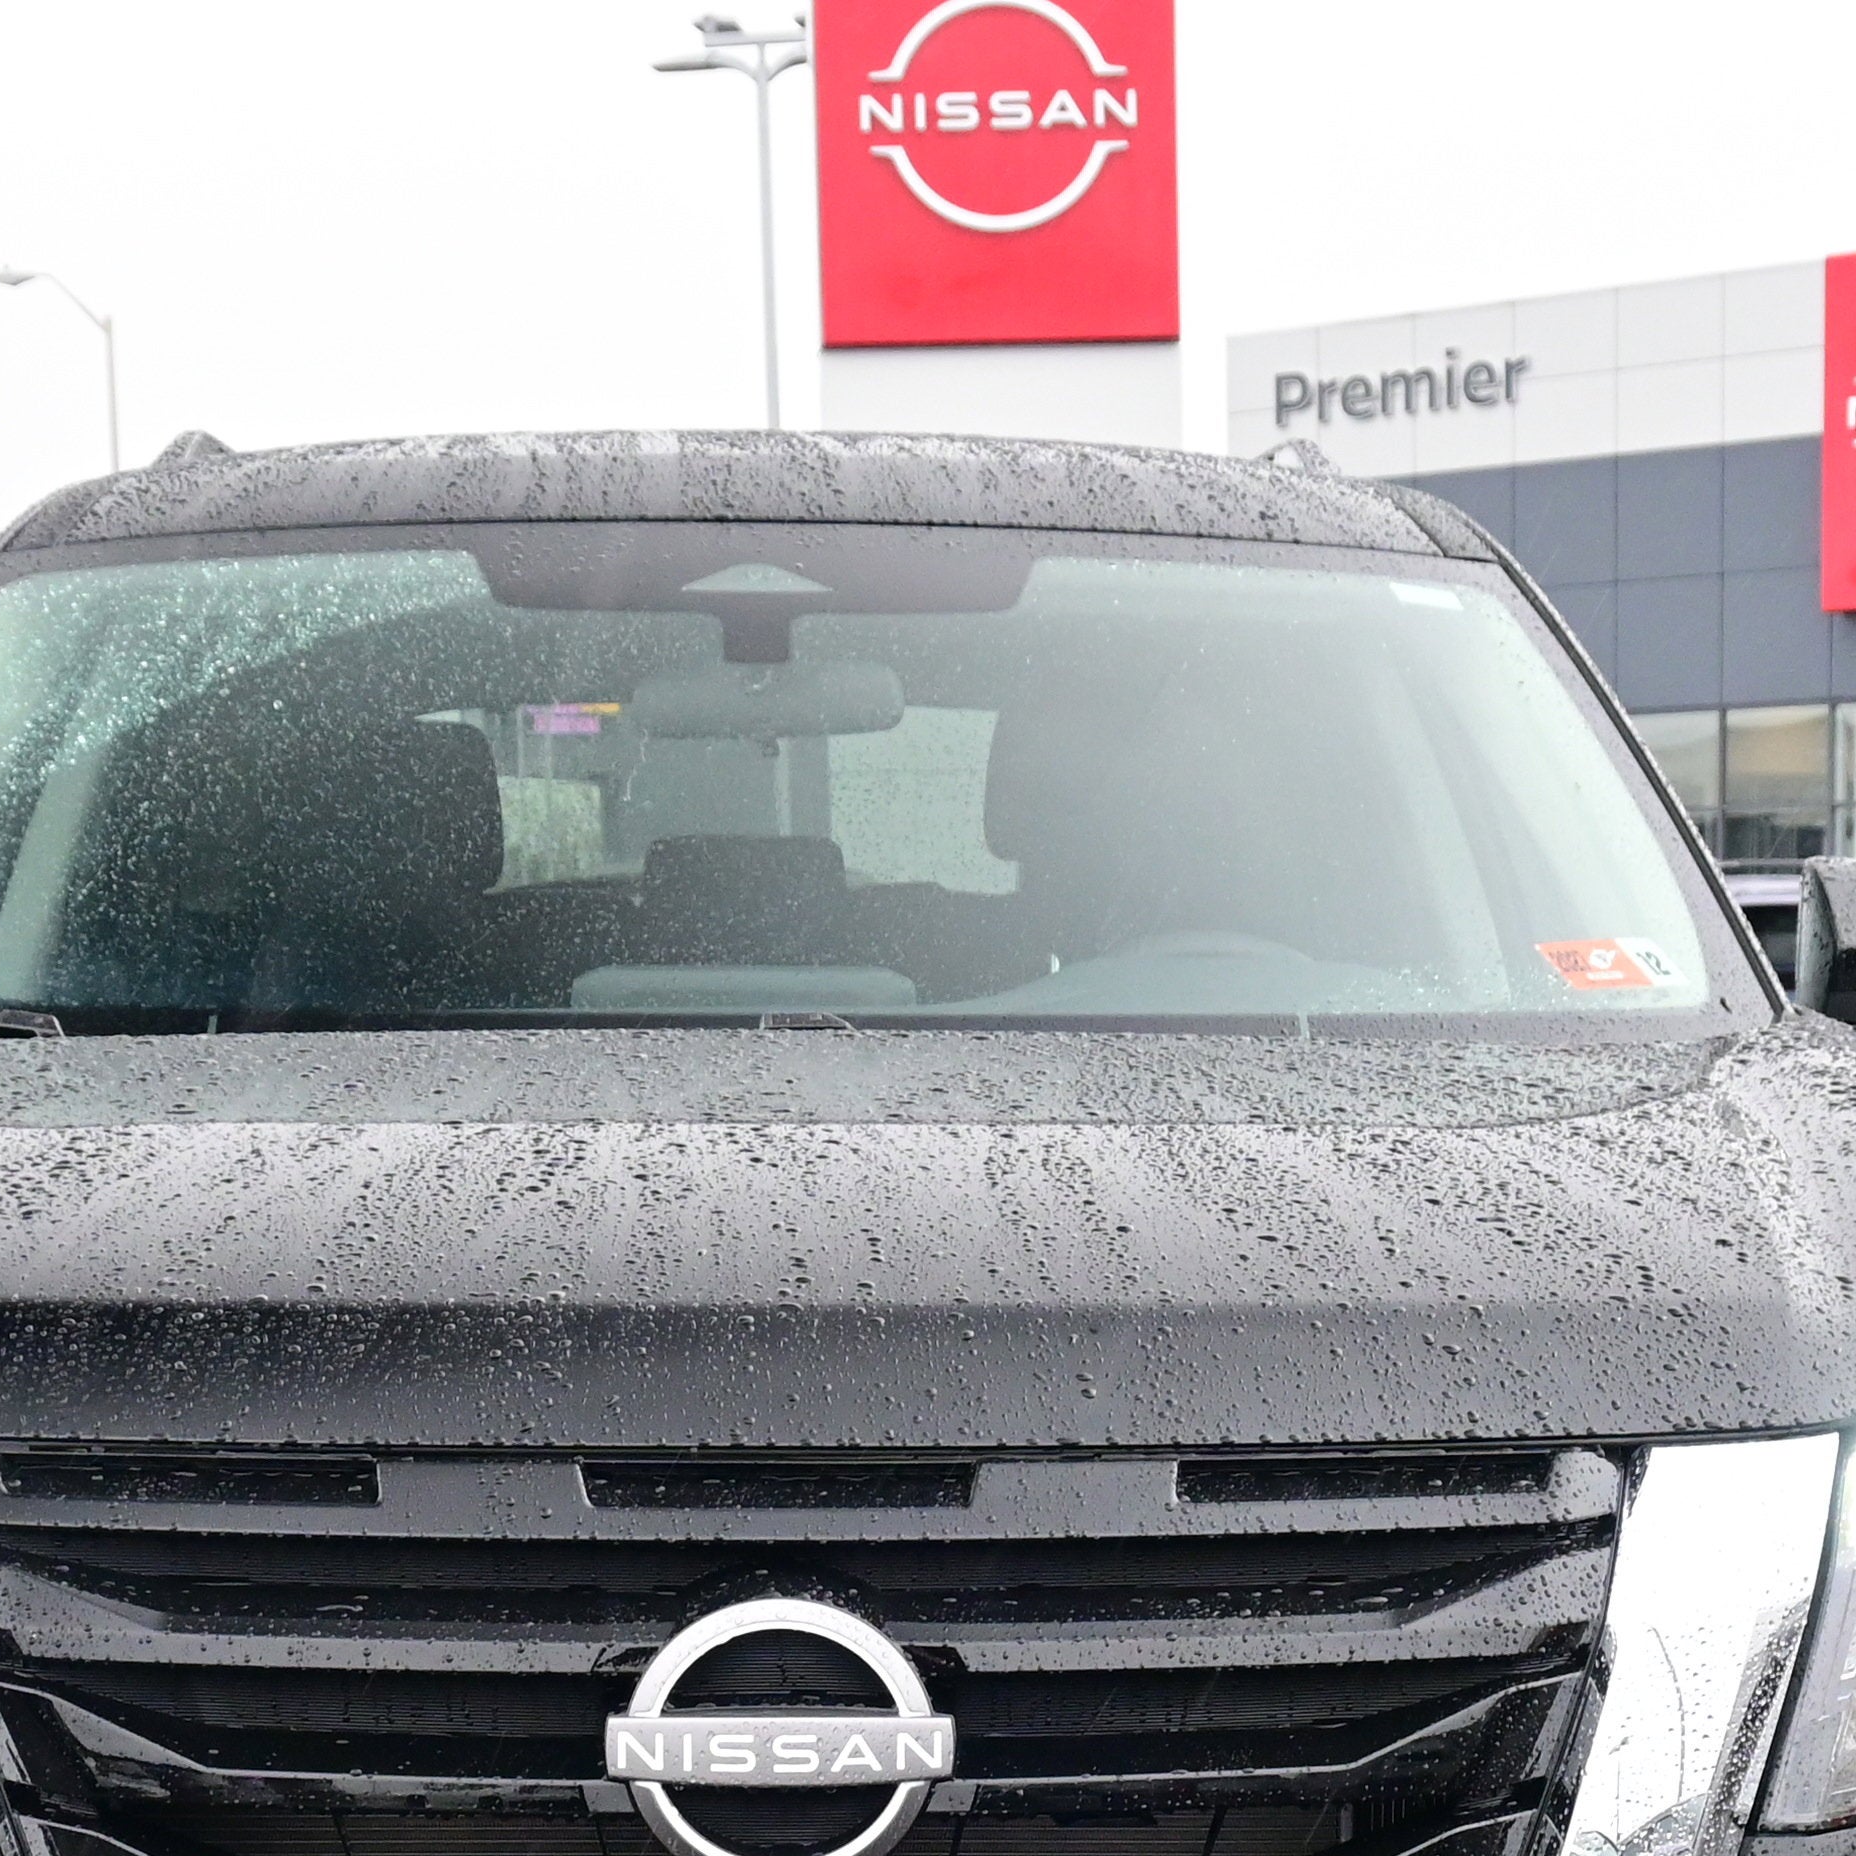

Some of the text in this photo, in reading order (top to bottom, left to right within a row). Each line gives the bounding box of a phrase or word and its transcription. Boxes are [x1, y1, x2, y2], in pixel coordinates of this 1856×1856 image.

[858, 87, 1139, 133] NISSAN
[1274, 346, 1529, 427] Premier
[1636, 951, 1671, 976] 12
[616, 1730, 943, 1773] NISSAN
